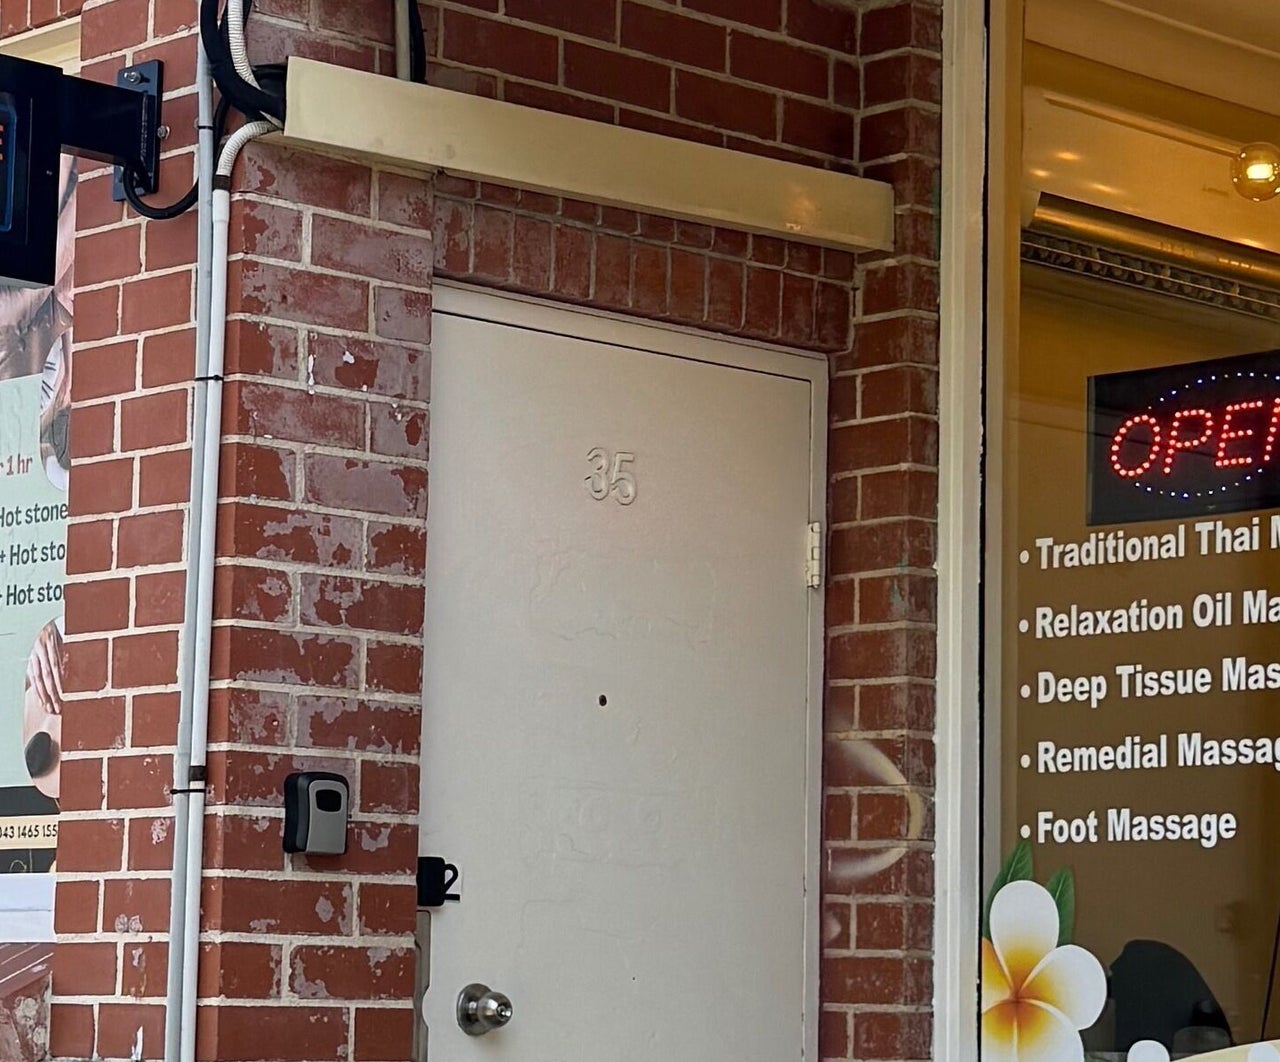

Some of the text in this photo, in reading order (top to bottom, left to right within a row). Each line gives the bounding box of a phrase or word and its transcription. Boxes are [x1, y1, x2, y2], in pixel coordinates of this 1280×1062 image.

[7, 456, 14, 476] 1
[17, 453, 33, 475] hr
[585, 447, 637, 506] 35
[25, 503, 68, 524] stone
[10, 543, 37, 566] Hot
[1036, 525, 1185, 569] Traditional
[1195, 518, 1260, 557] Thai
[6, 583, 34, 606] Hot
[1035, 600, 1183, 638] Relaxation
[1193, 593, 1231, 627] Oil
[1038, 670, 1107, 708] Deep
[1116, 664, 1212, 699] Tissue
[1038, 735, 1167, 774] Remedial
[42, 824, 58, 838] 155
[1038, 808, 1237, 848] Foot Massage
[445, 864, 460, 900] 2
